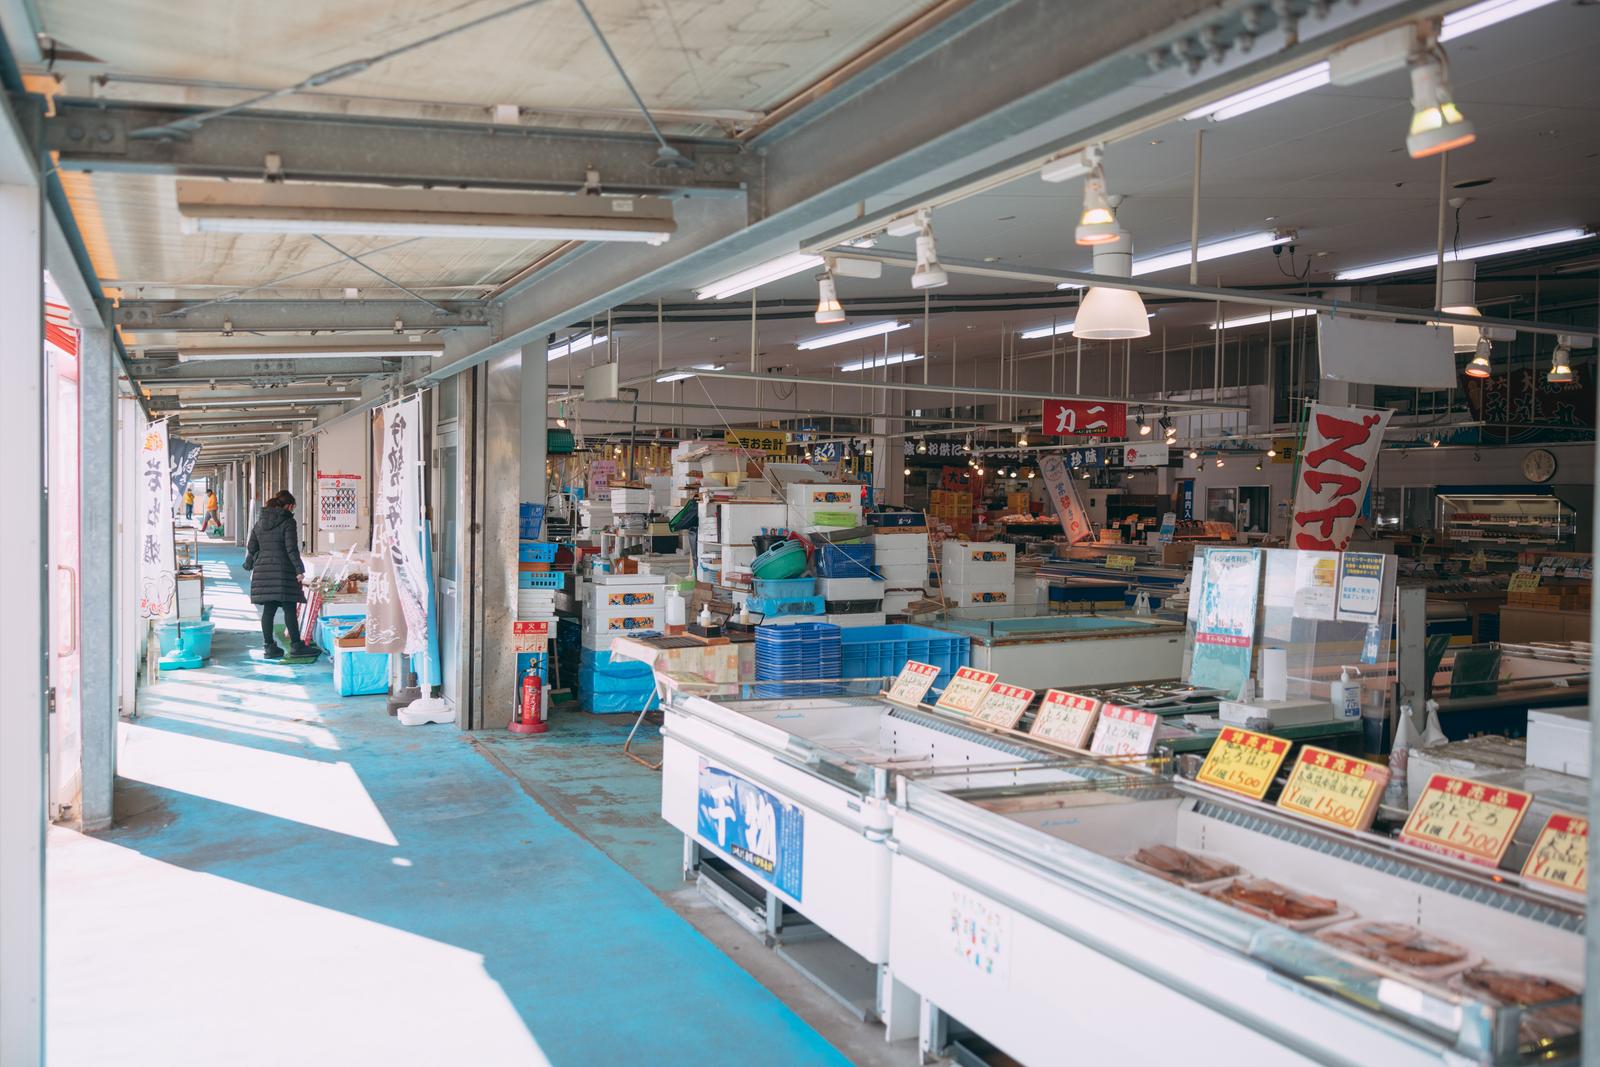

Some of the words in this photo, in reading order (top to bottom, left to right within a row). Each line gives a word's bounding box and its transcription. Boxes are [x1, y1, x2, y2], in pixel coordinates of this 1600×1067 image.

[1056, 405, 1108, 433] カニ
[904, 441, 963, 457] 旅お供に
[1070, 448, 1098, 467] 珍味
[335, 480, 341, 488] 2
[1184, 489, 1193, 521] 館内入
[1231, 731, 1275, 753] 特売品
[1316, 751, 1364, 777] 特売品
[1229, 768, 1260, 788] 1500
[1445, 779, 1509, 806] 特売品
[1314, 795, 1356, 822] 1500
[708, 784, 777, 868] 干物
[1448, 820, 1499, 852] 1500
